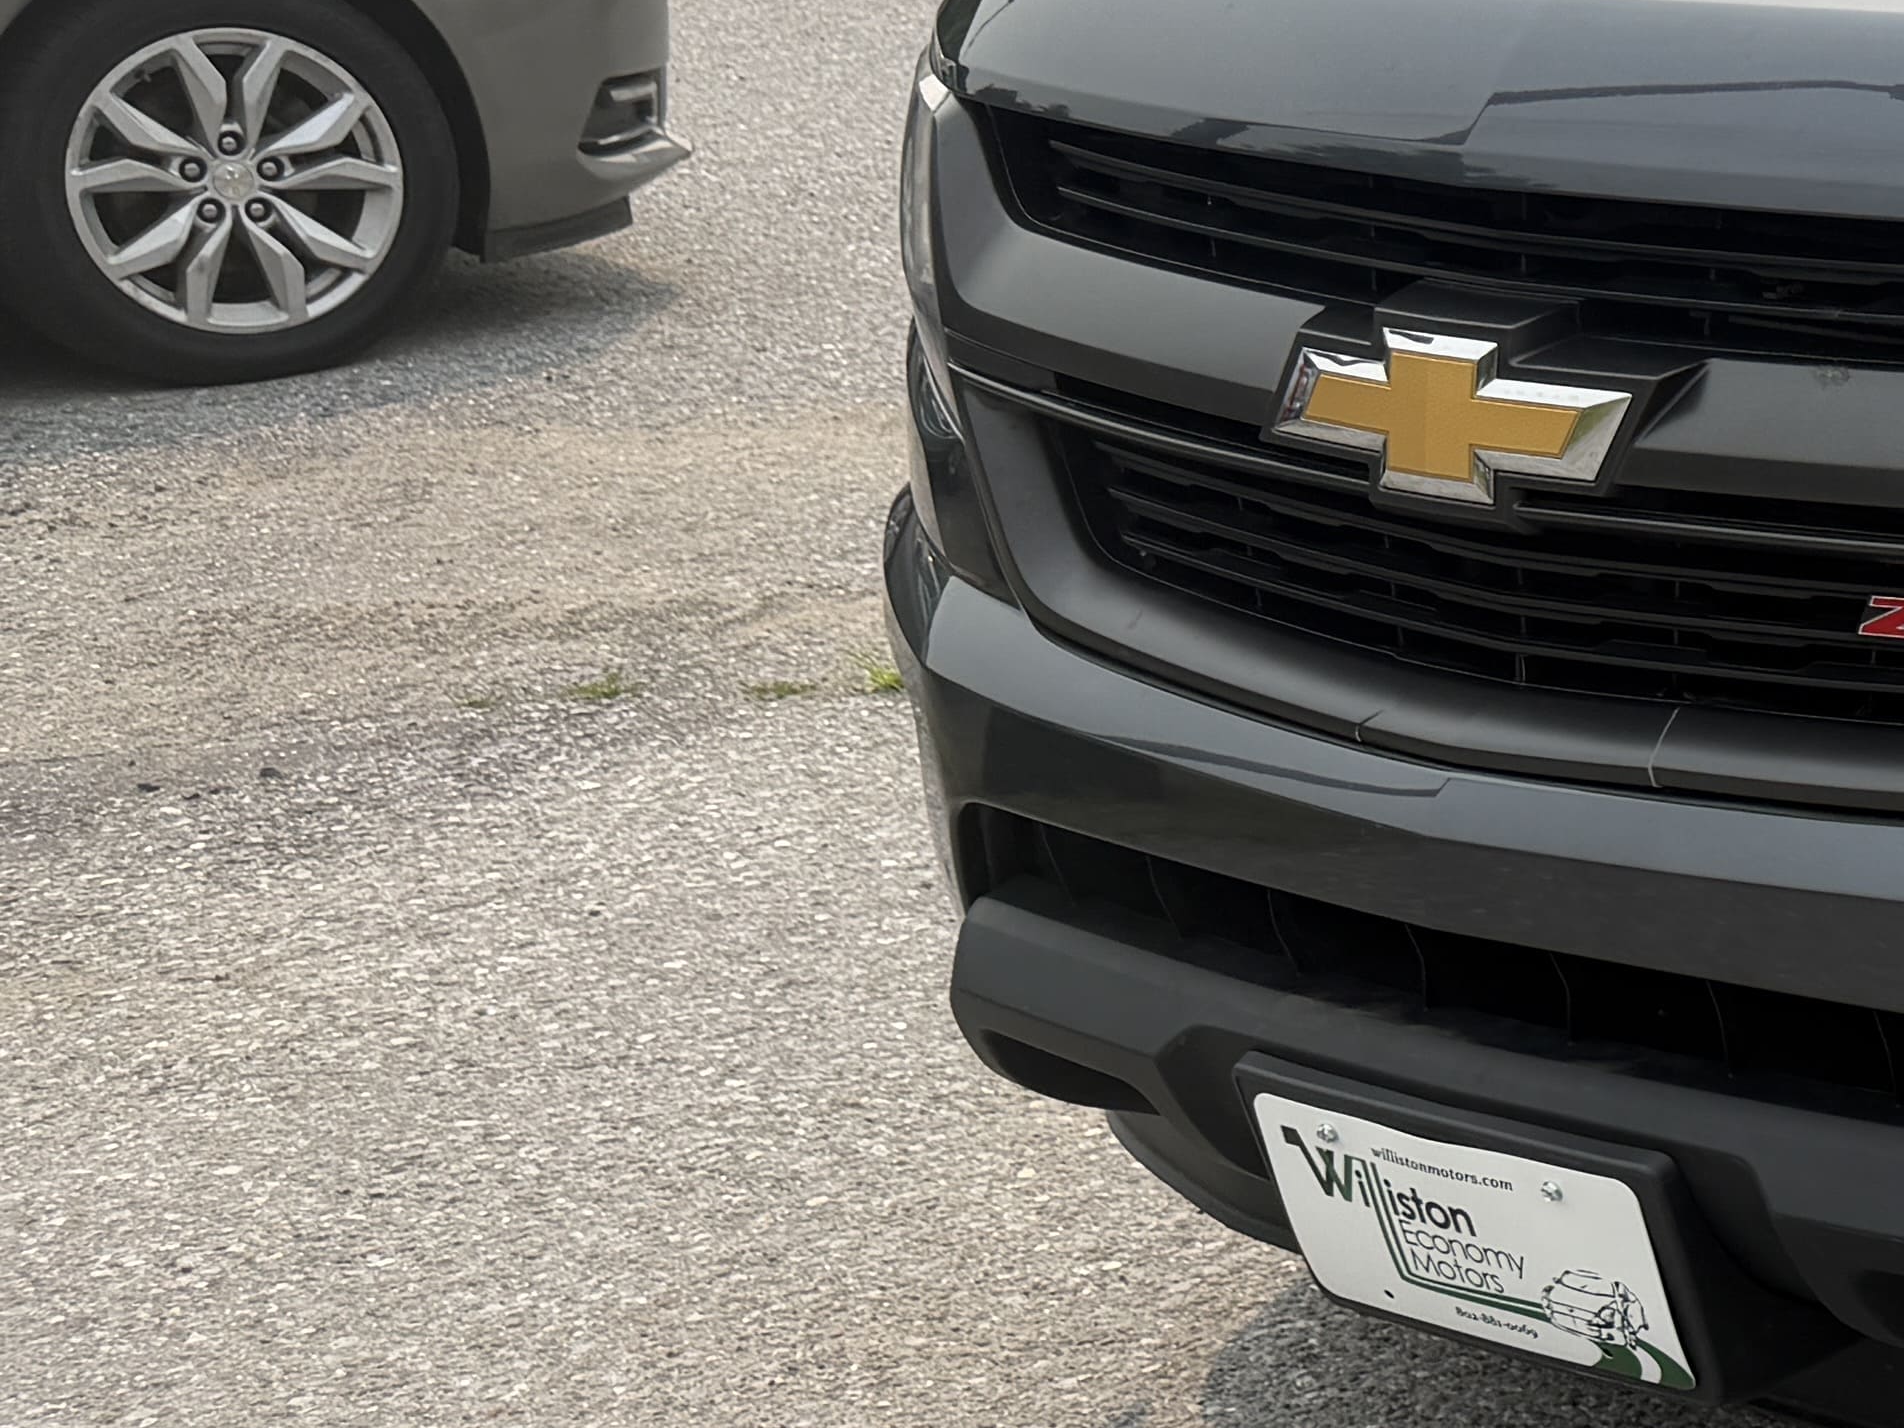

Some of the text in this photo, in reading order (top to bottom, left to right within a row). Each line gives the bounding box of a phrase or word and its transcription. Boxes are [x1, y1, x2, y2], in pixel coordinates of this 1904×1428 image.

[1280, 1125, 1477, 1237] Williston
[1371, 1148, 1513, 1191] willistonmotors.com
[1399, 1218, 1524, 1279] Economy
[1411, 1249, 1505, 1293] Motors
